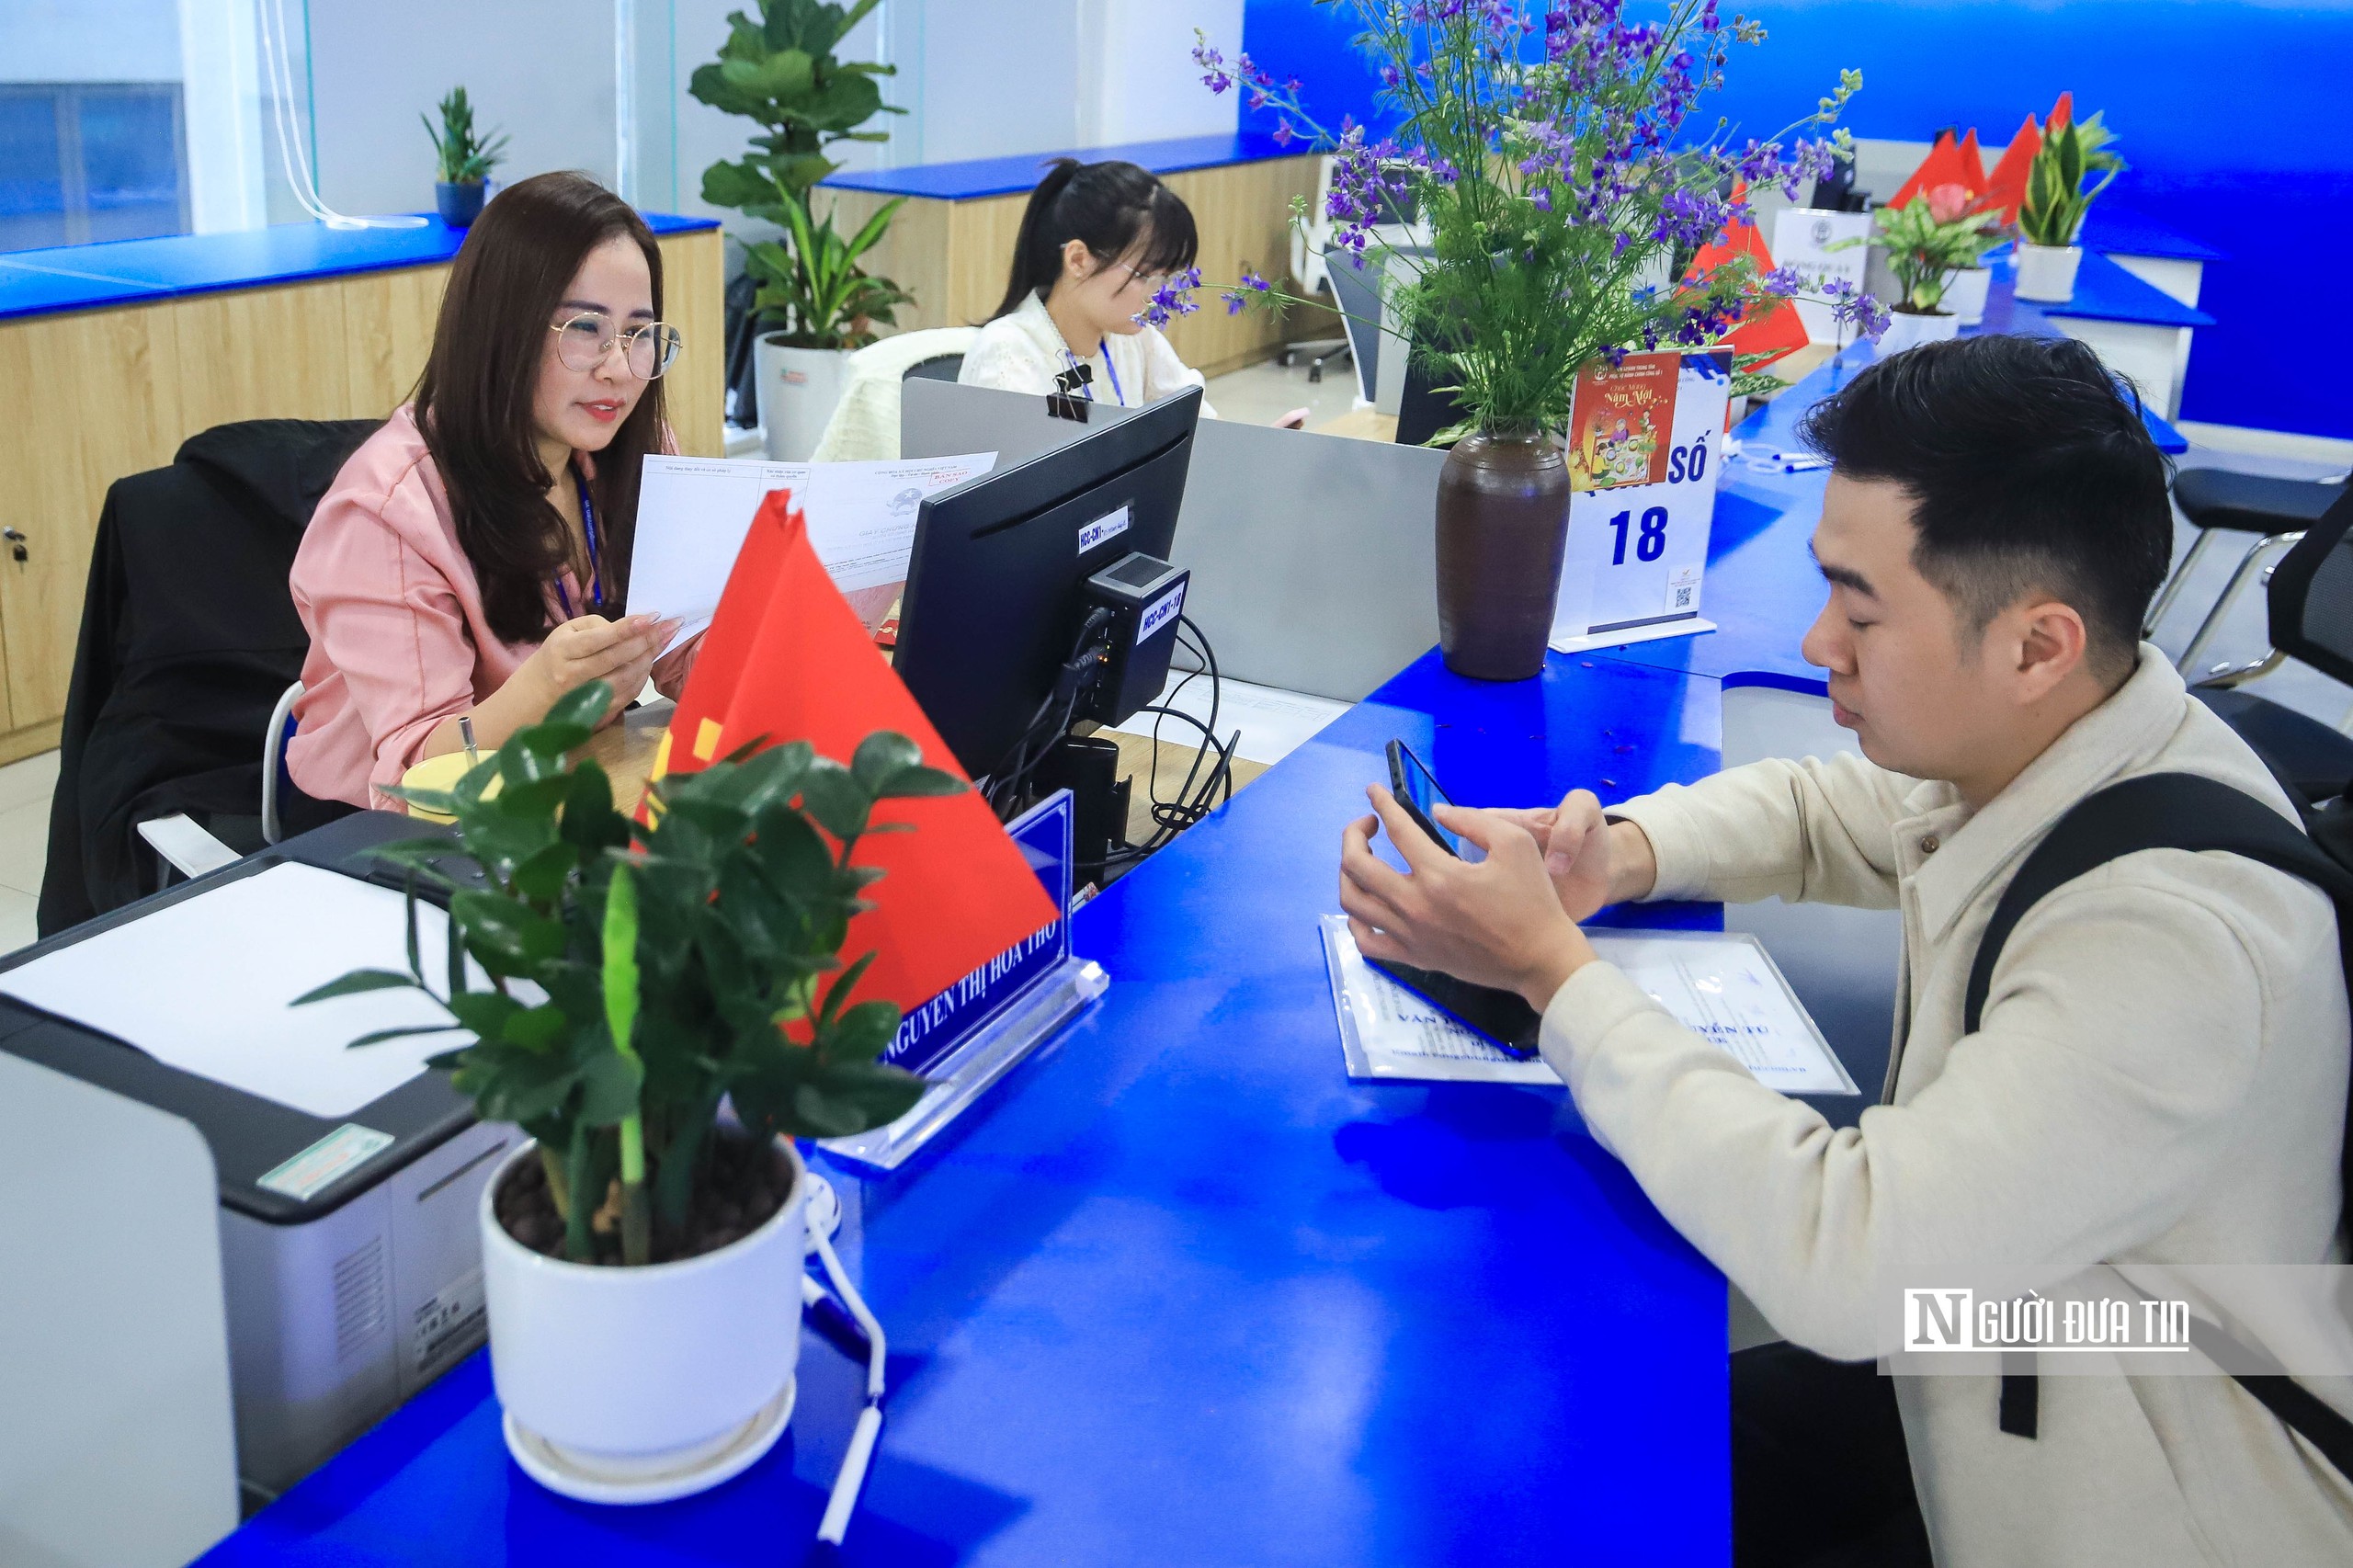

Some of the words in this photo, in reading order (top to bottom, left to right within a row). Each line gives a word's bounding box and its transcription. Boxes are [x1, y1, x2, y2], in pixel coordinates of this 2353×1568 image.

[1604, 392, 1635, 408] Năm
[1632, 389, 1653, 405] Mới
[1668, 429, 1711, 484] SỐ
[1609, 506, 1669, 566] 18
